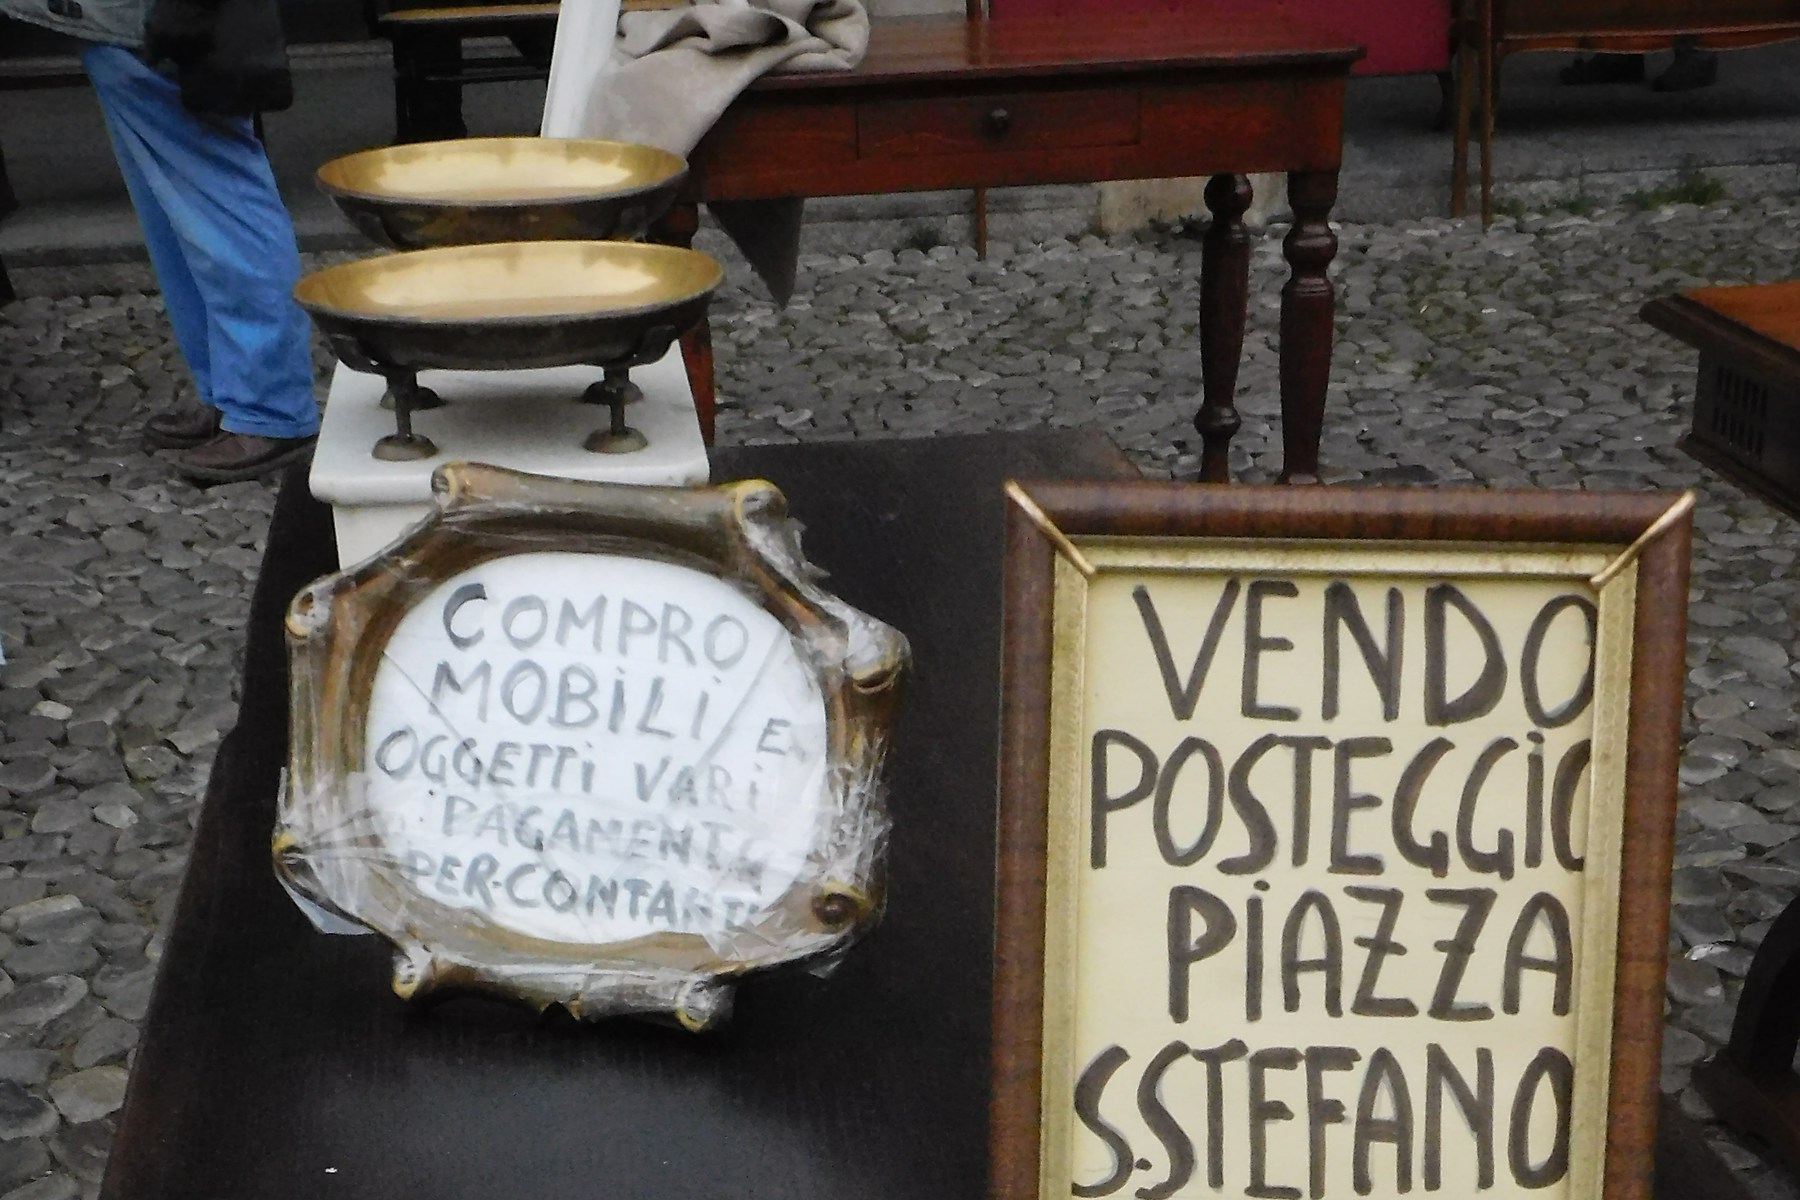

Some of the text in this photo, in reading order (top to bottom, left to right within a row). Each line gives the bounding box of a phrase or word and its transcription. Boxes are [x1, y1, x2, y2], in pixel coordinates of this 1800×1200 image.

[442, 582, 749, 670] COMPRO
[1132, 578, 1599, 729] VENDO
[757, 717, 791, 755] E
